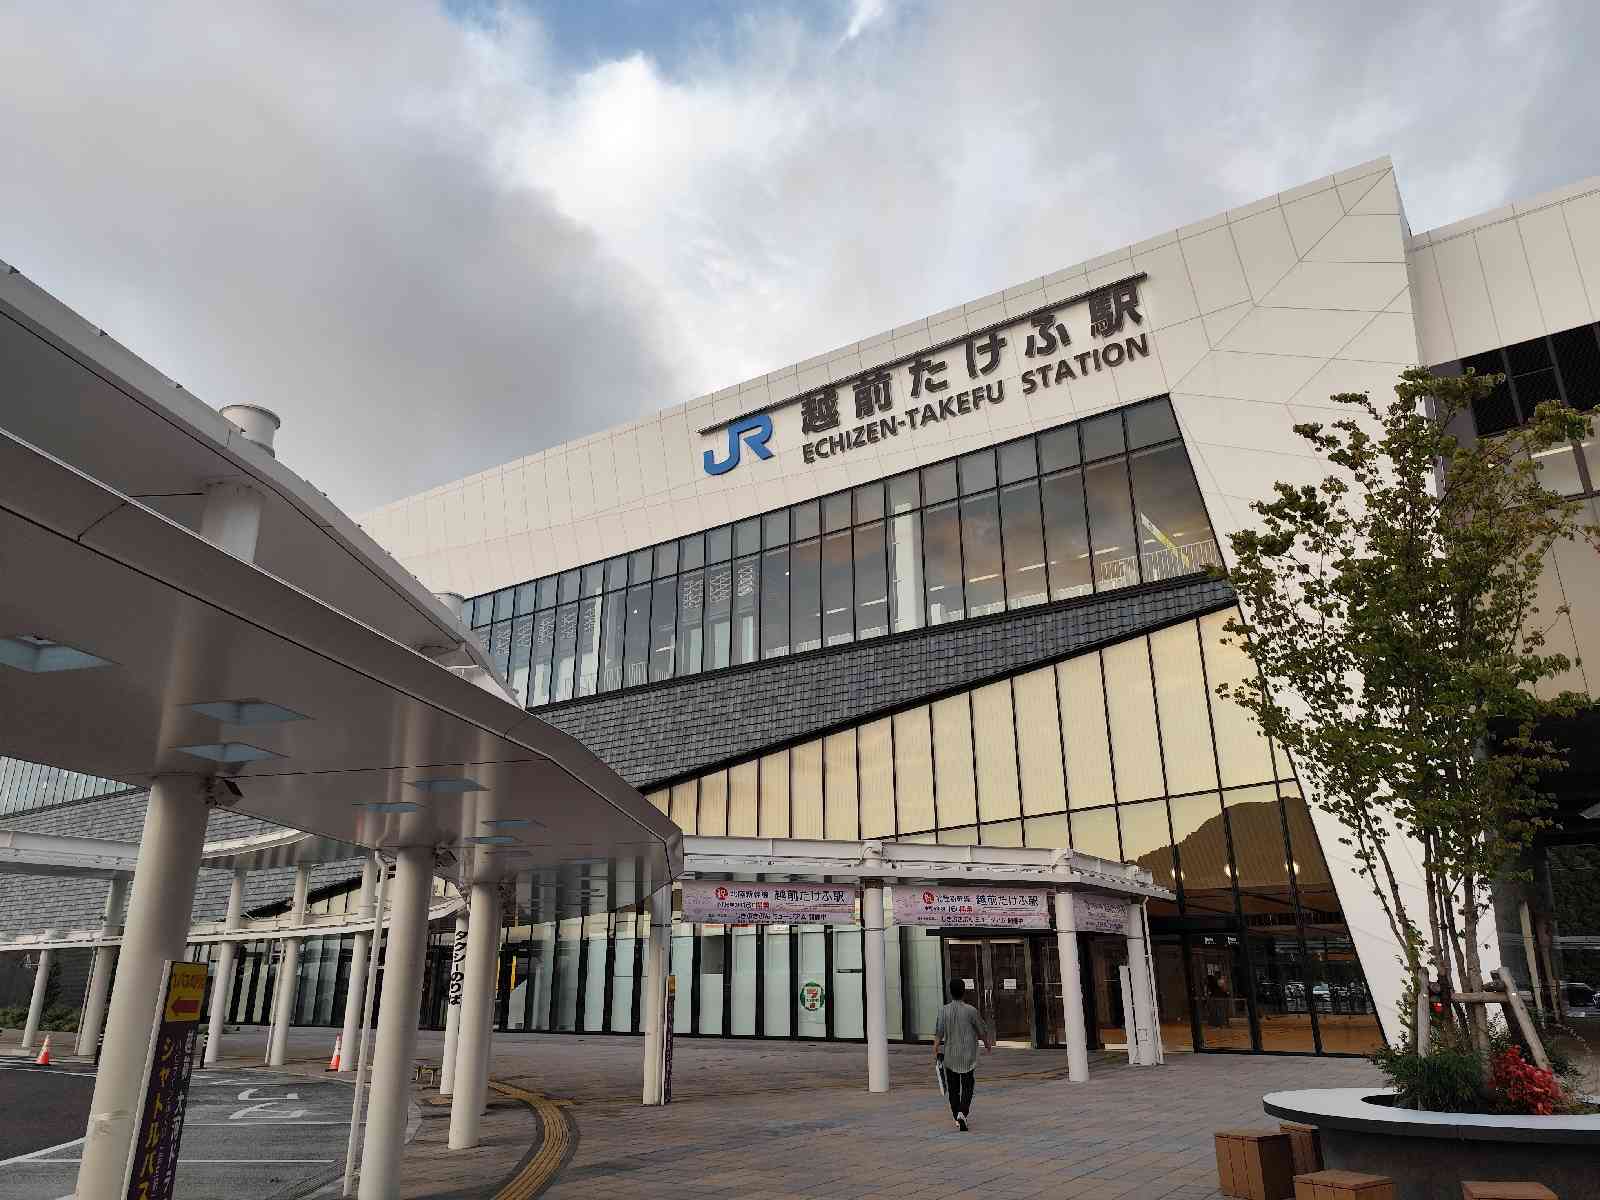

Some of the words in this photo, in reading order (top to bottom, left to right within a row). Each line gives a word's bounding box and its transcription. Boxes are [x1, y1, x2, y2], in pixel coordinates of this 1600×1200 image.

[801, 280, 1145, 434] 越前たけふ駅
[802, 379, 1006, 464] ECHIZEN-TAKEFU
[1021, 332, 1150, 395] STATION
[703, 411, 776, 477] JR
[449, 930, 468, 1005] タクシーのりば
